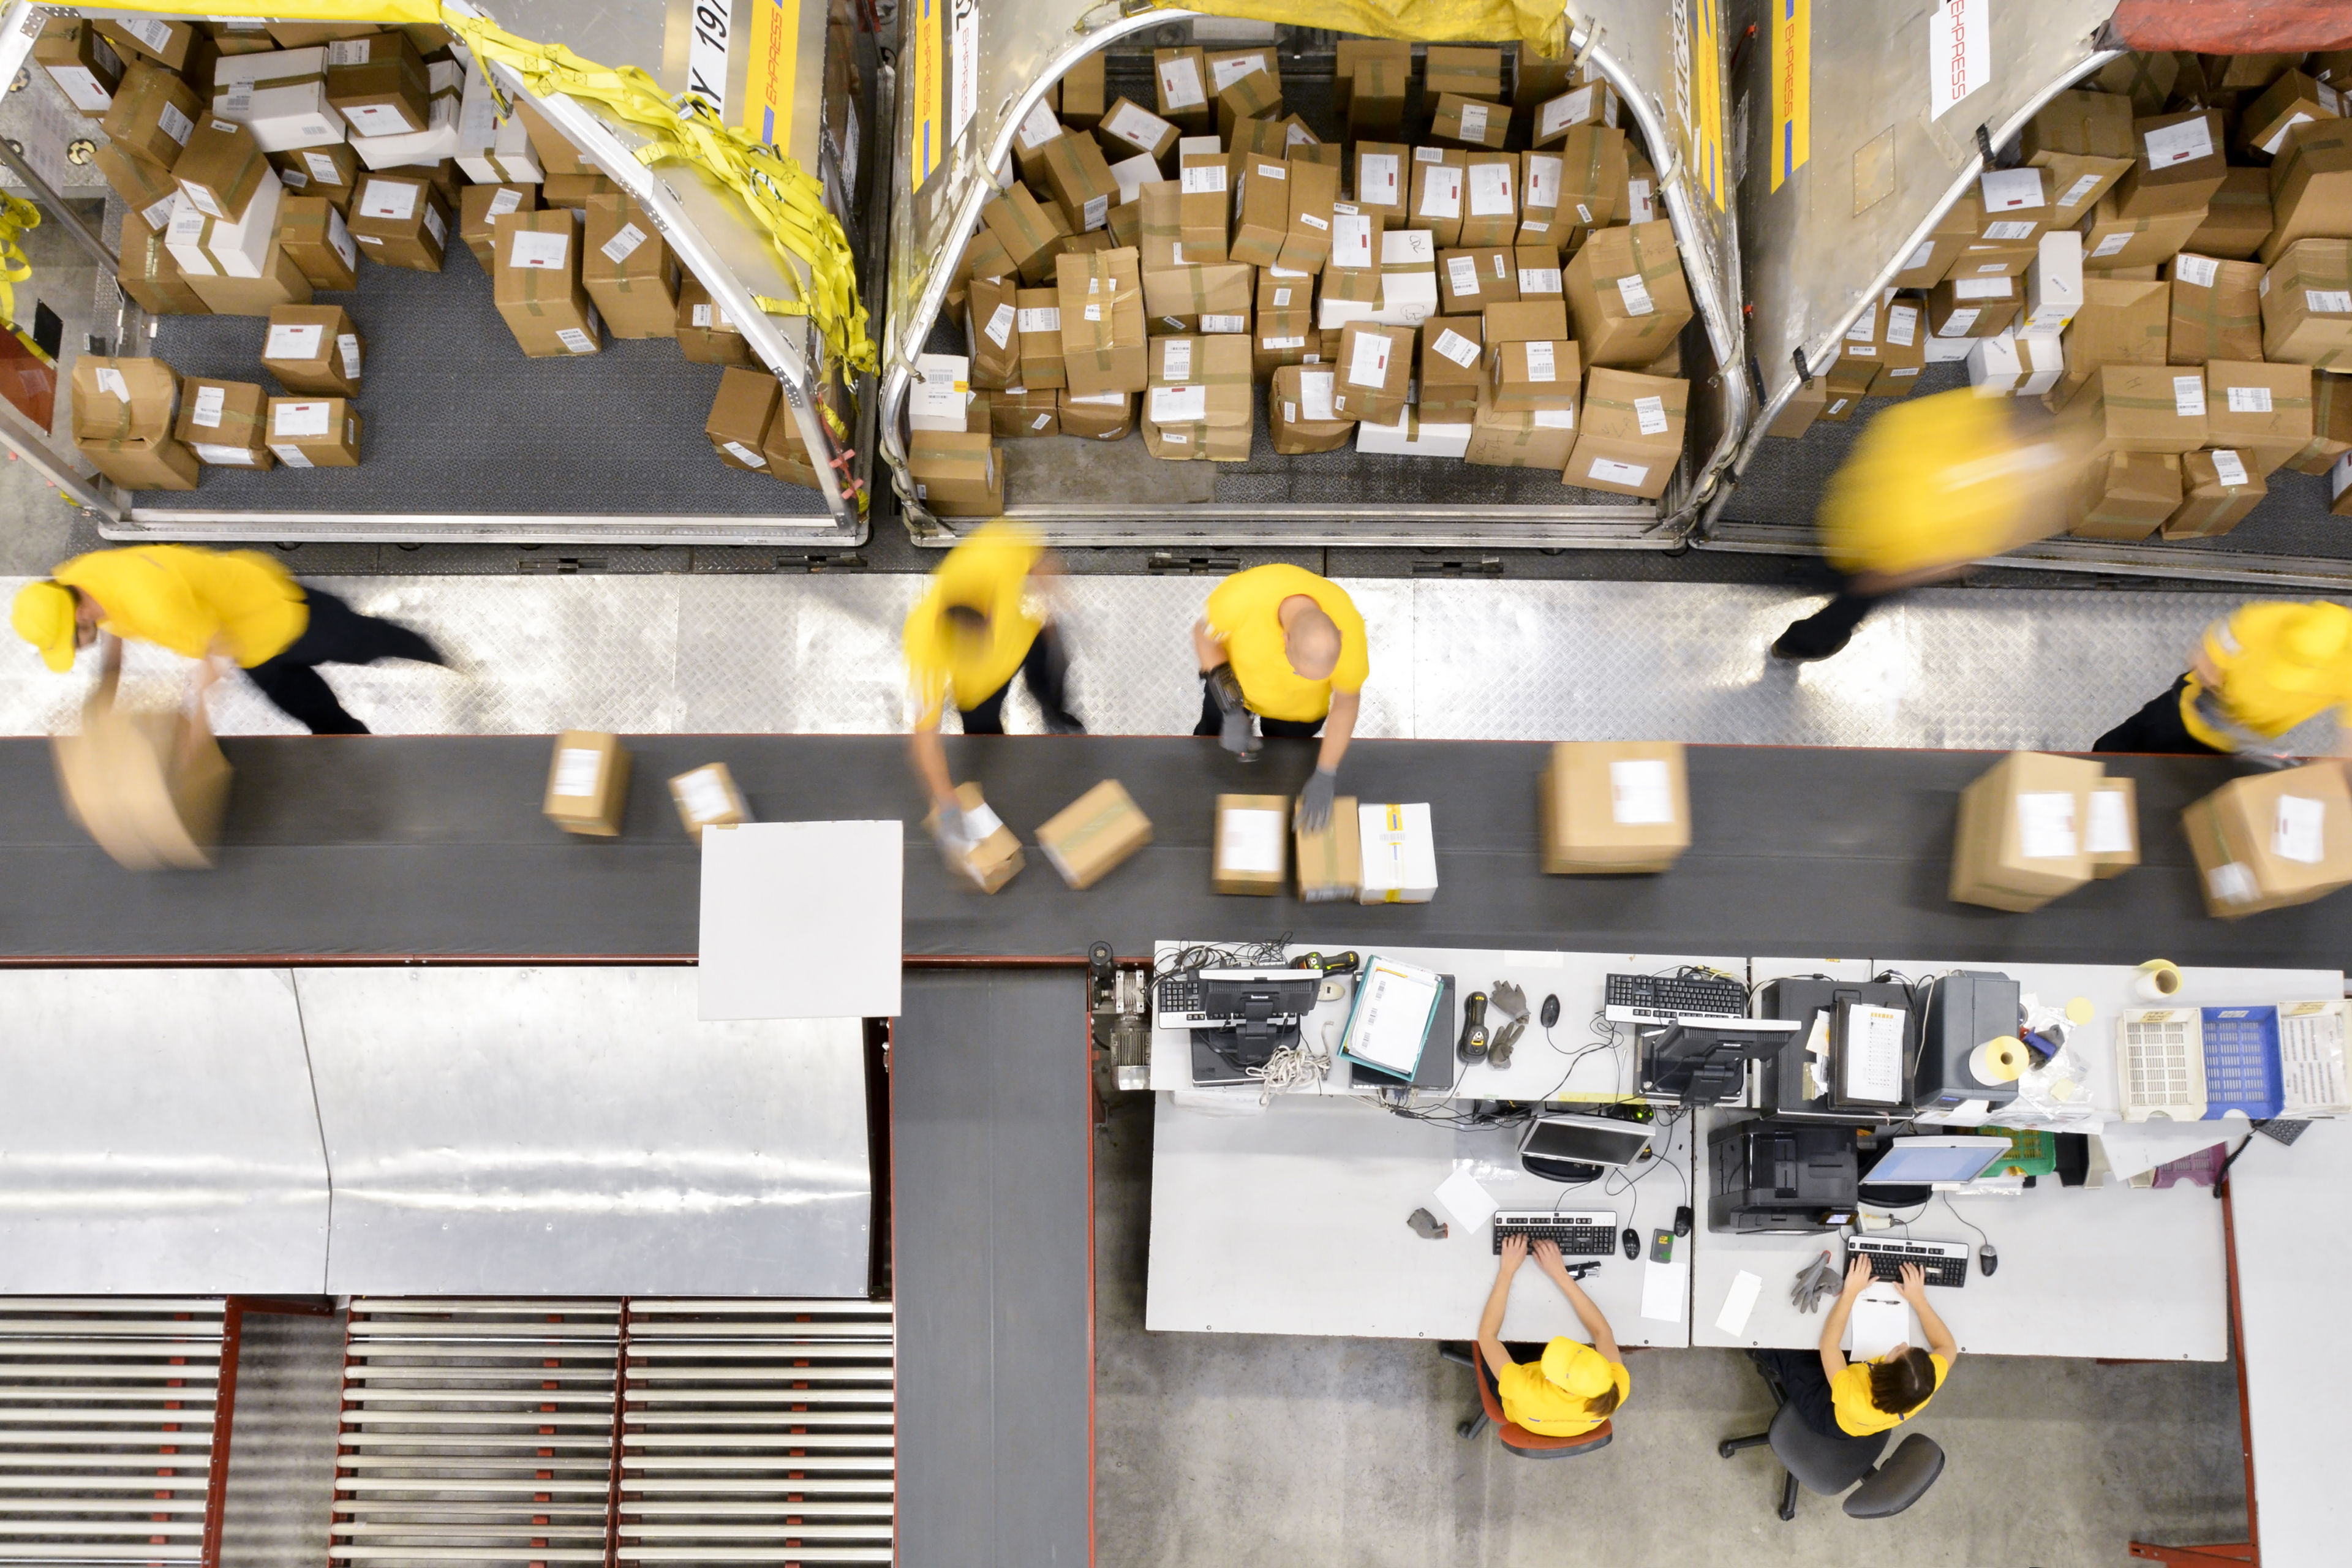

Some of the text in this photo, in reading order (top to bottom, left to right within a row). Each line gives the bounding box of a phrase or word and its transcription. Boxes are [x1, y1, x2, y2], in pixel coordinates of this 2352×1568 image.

[766, 7, 783, 106] EXPRESS
[1784, 23, 1794, 118] EXPRESS
[1951, 0, 1966, 100] EXPRESS
